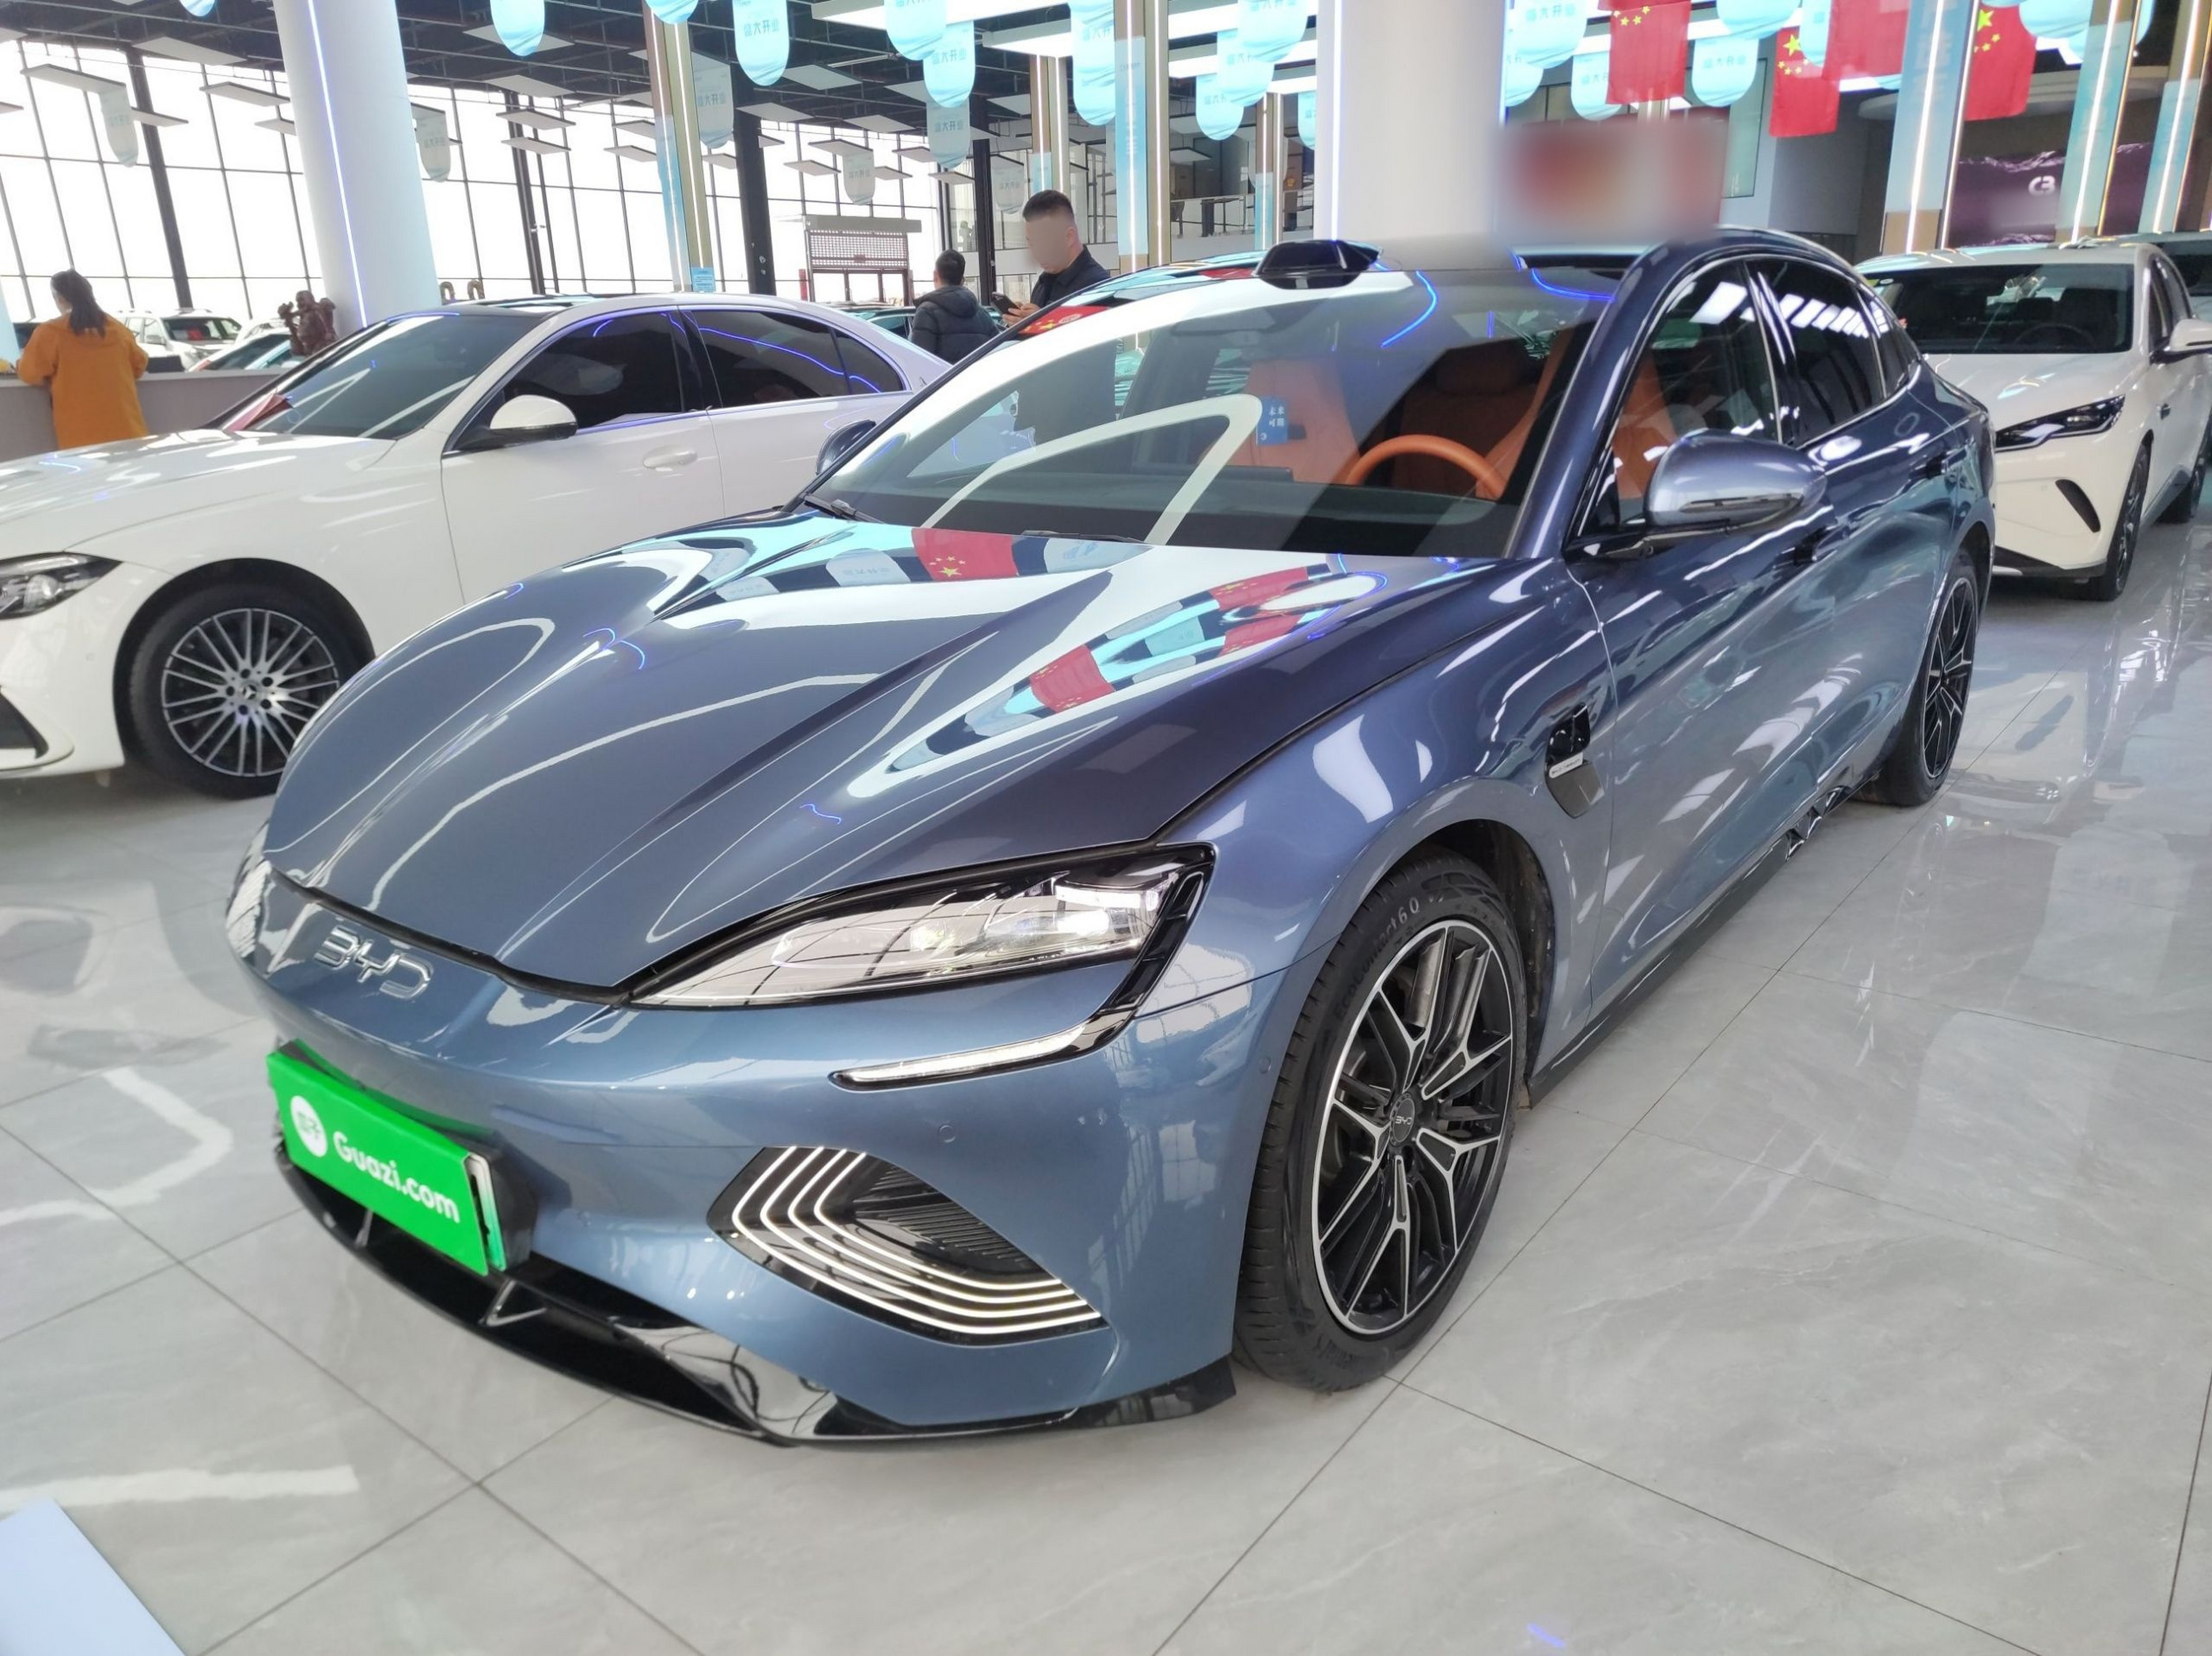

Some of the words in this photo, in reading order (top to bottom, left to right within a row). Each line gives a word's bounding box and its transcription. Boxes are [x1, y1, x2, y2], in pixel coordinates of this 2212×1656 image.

[314, 925, 434, 999] BYD
[1395, 1116, 1412, 1125] BYD
[334, 1131, 460, 1224] Guazi.com
